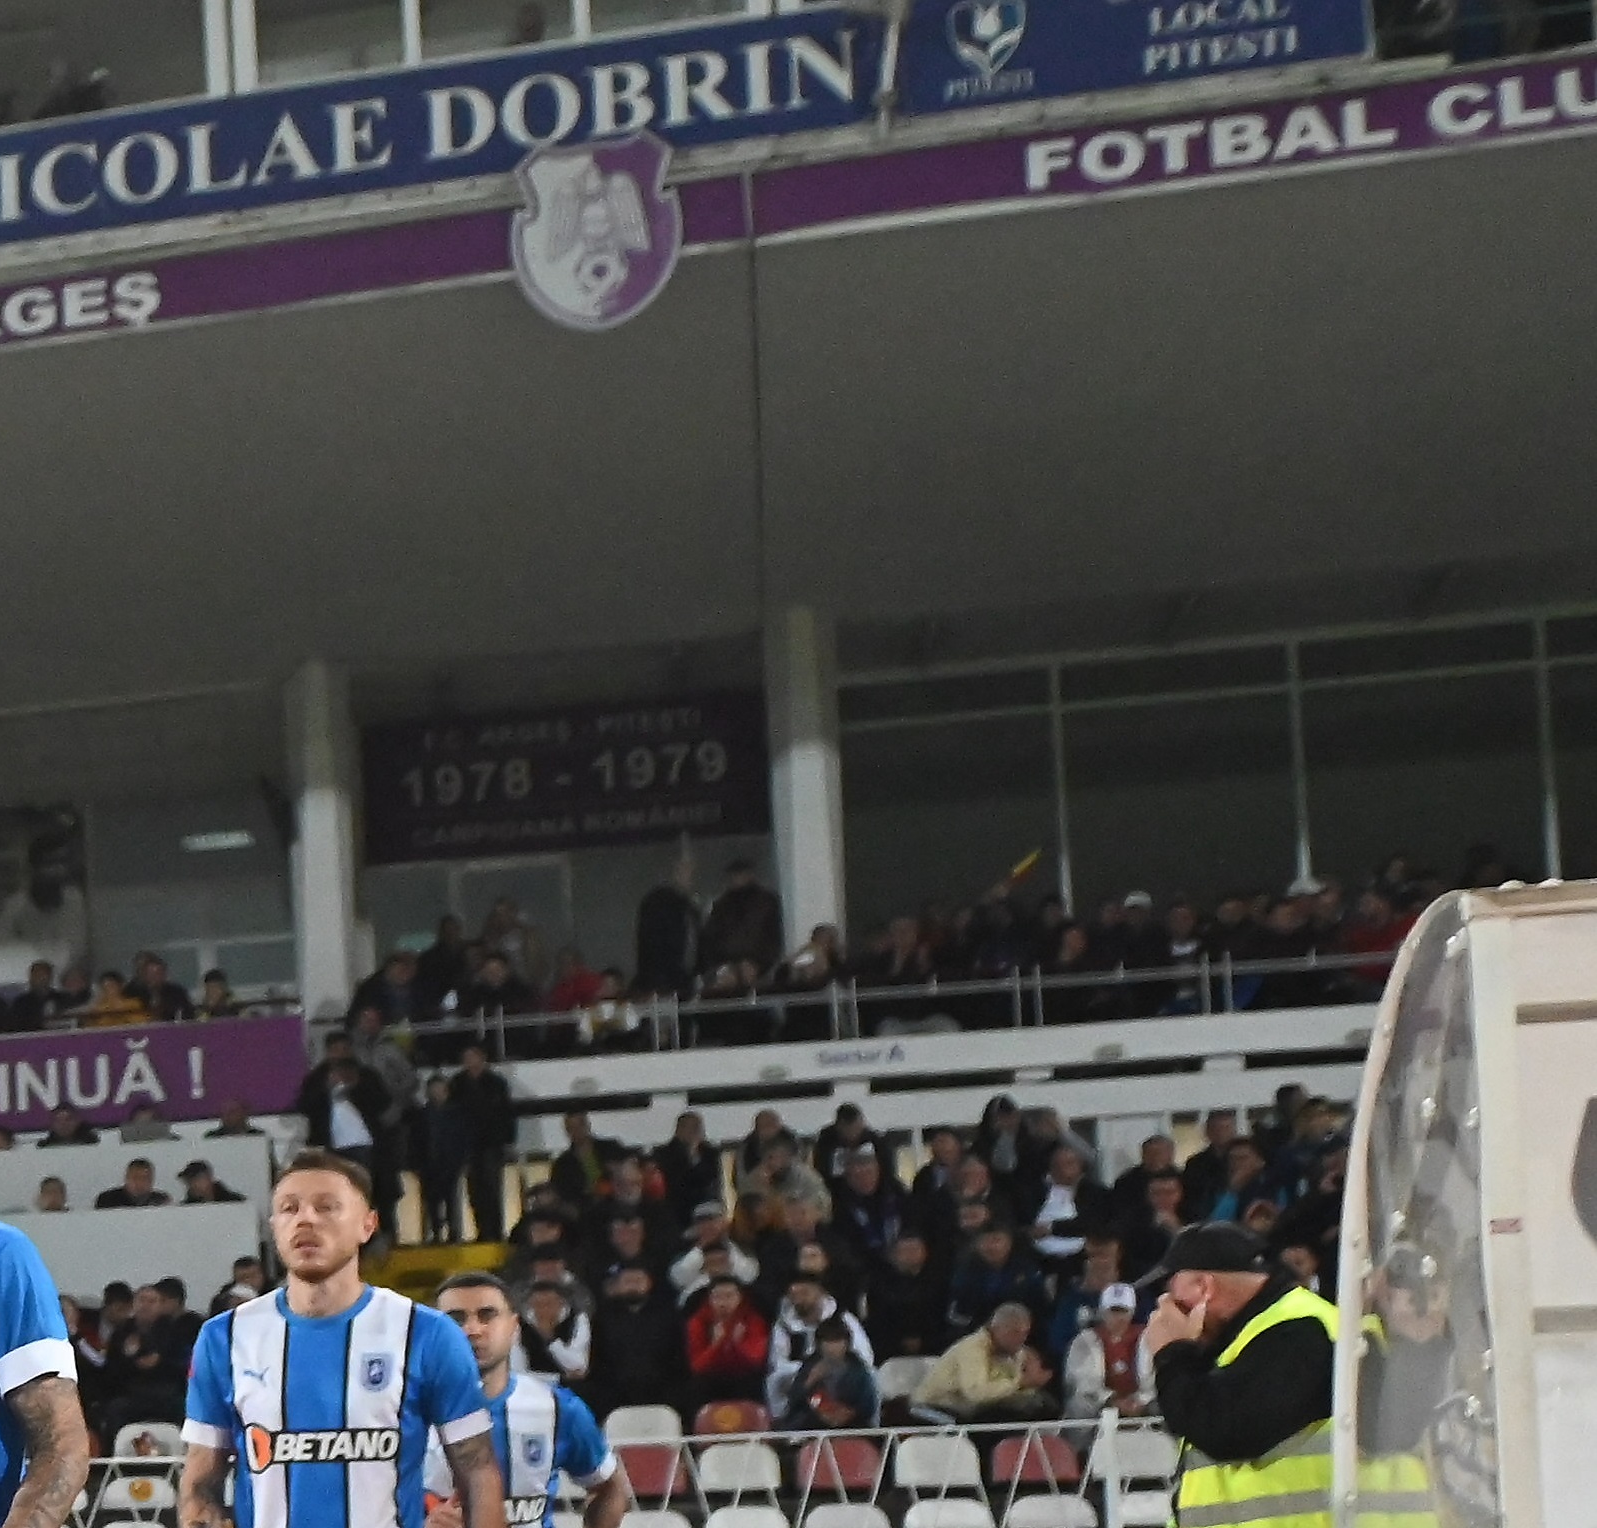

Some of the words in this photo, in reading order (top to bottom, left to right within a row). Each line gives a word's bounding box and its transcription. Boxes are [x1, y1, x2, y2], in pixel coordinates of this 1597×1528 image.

[428, 30, 863, 162] DOBRIN
[1024, 98, 1399, 192] FOTBAL
[401, 758, 534, 808] 1978
[592, 739, 728, 791] 1979
[274, 1429, 399, 1462] BETANO
